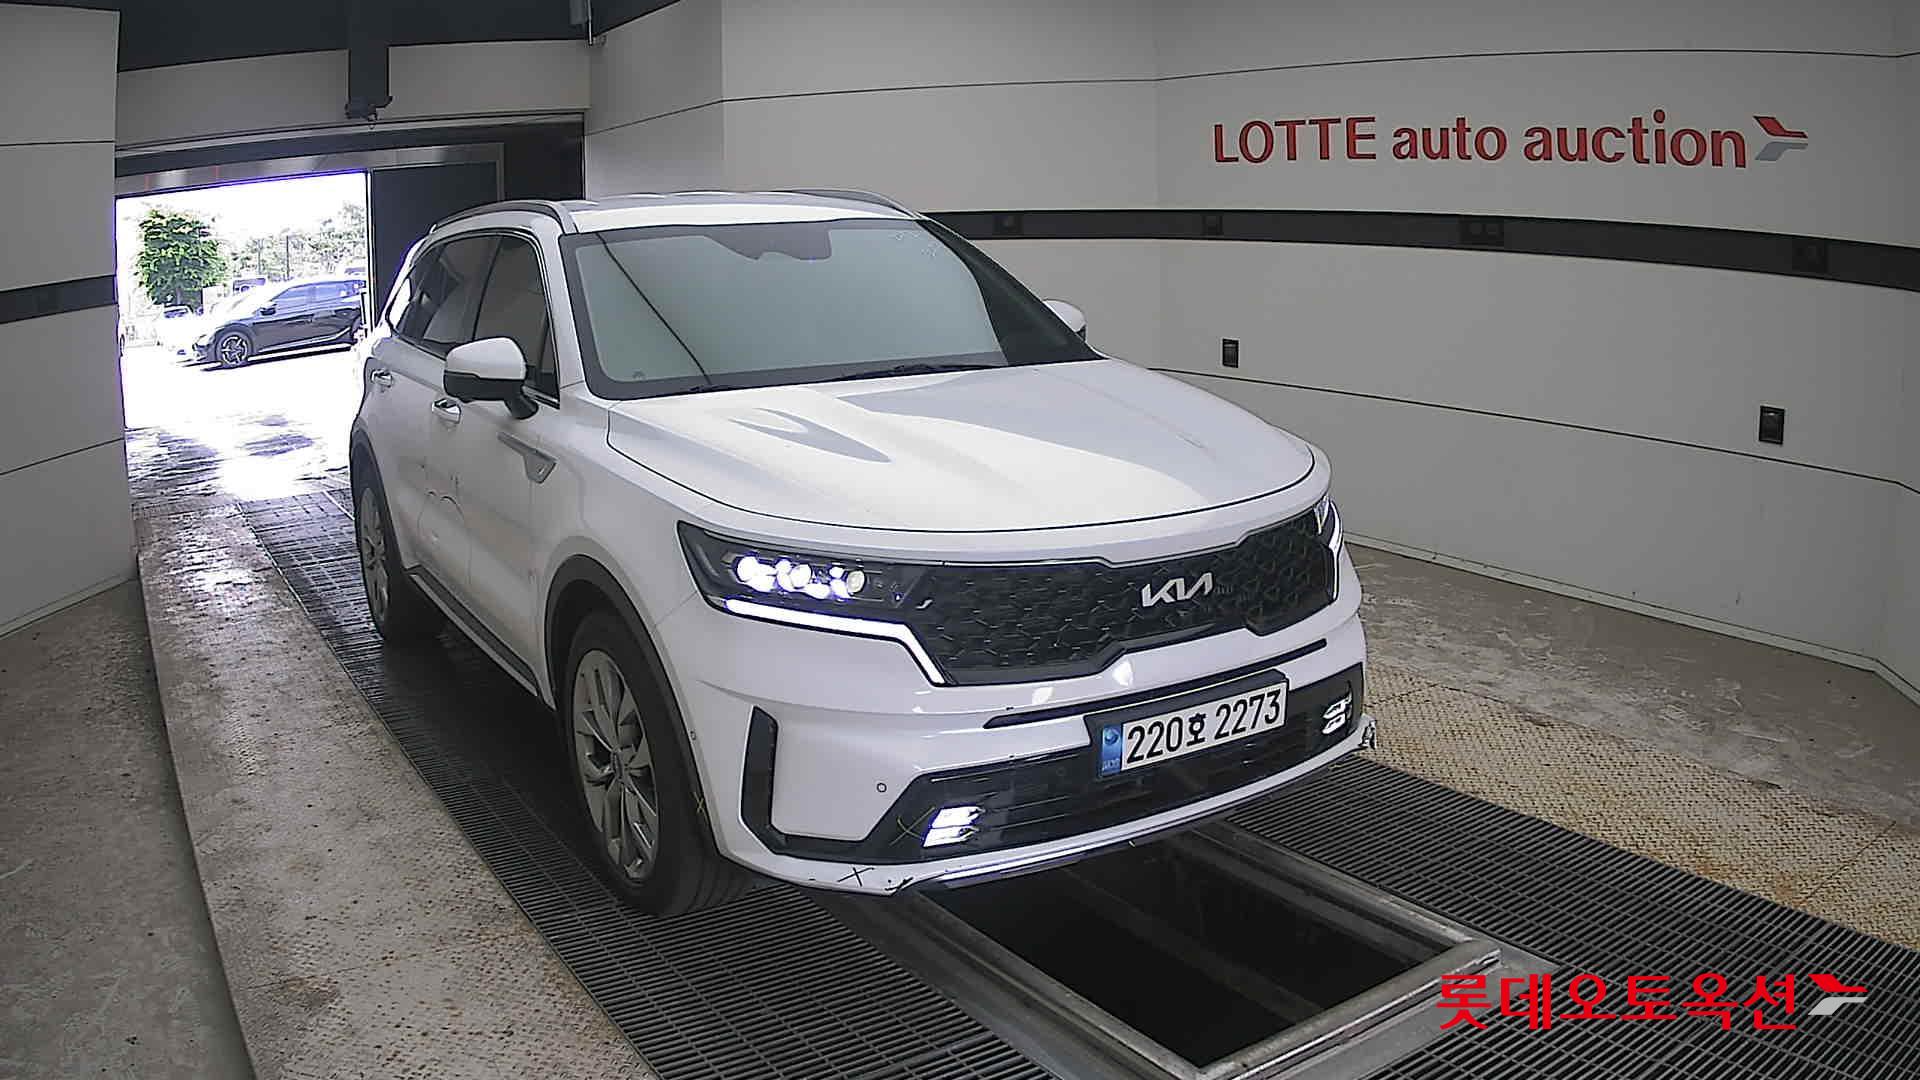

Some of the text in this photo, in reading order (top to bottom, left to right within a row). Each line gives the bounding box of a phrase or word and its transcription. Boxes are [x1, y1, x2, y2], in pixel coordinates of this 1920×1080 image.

[1213, 109, 1748, 169] LOTTE auto auction
[1141, 572, 1213, 607] KIA
[1126, 690, 1281, 764] 220호 2273
